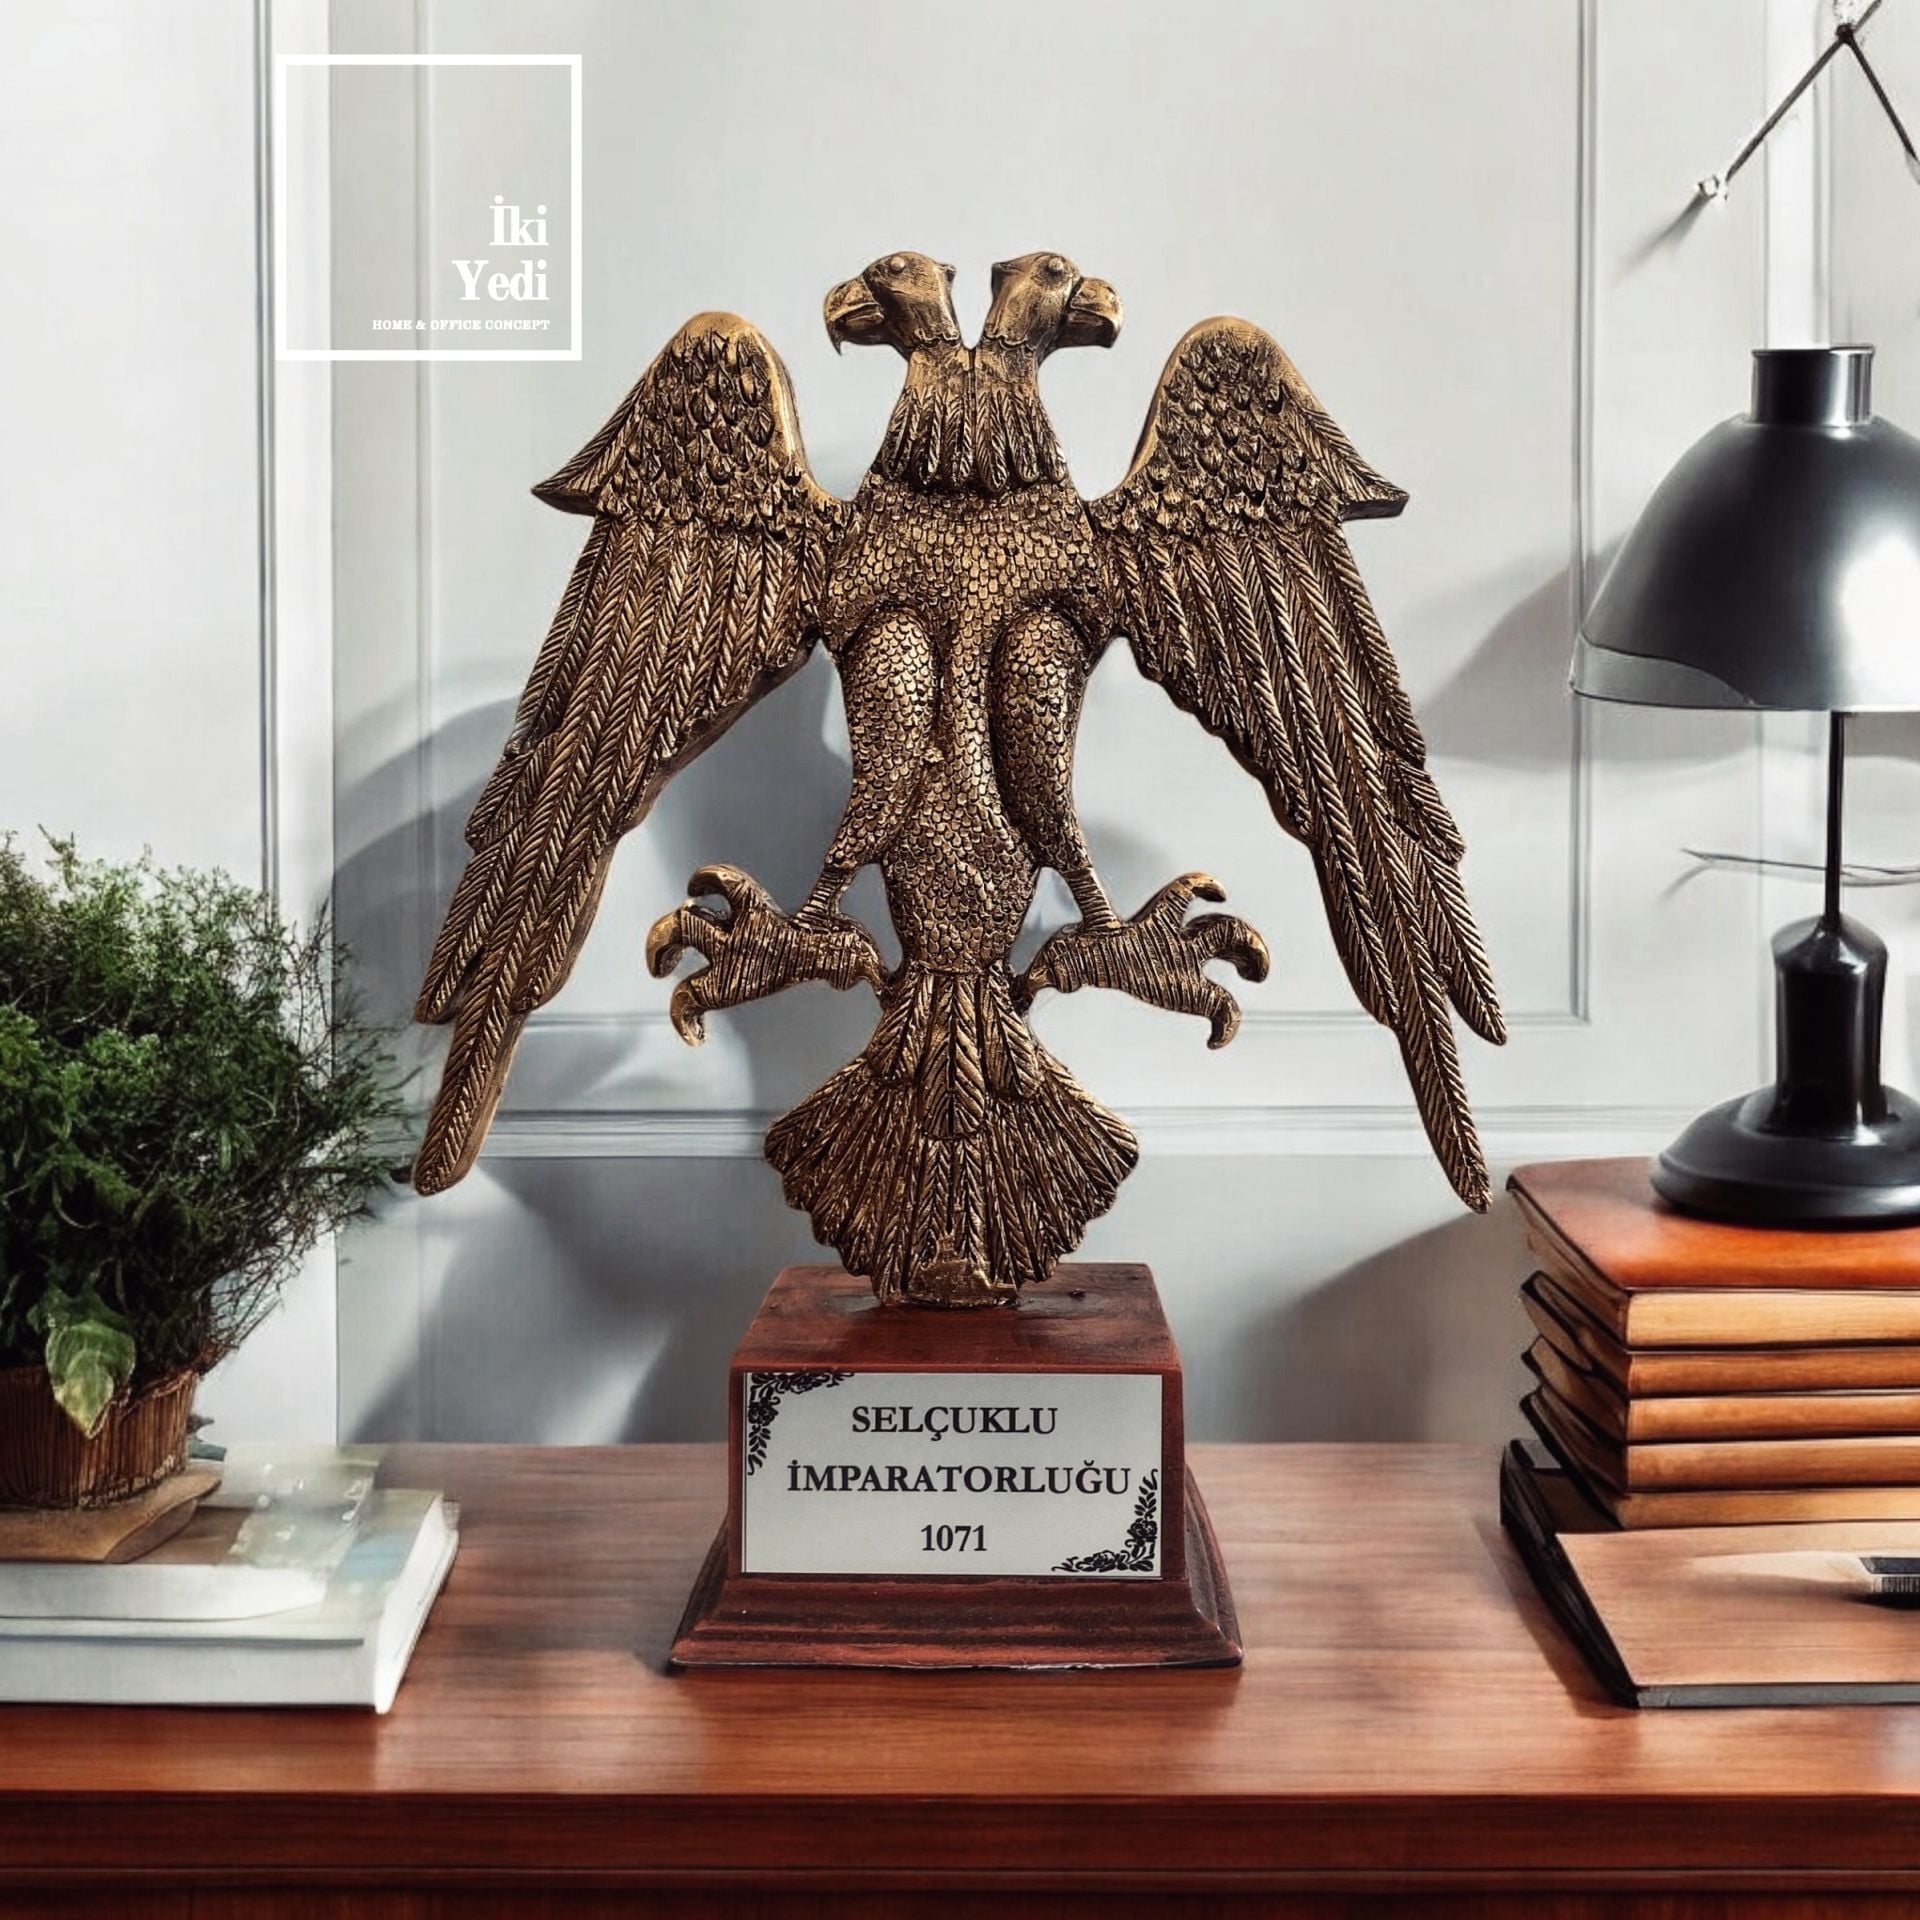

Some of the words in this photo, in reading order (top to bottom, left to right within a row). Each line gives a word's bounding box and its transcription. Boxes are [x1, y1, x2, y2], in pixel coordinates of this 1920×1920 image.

[851, 1406, 1058, 1442] SELÇUKLU
[786, 1459, 1132, 1495] İMPARATORLUĞU
[920, 1524, 988, 1552] 1071
